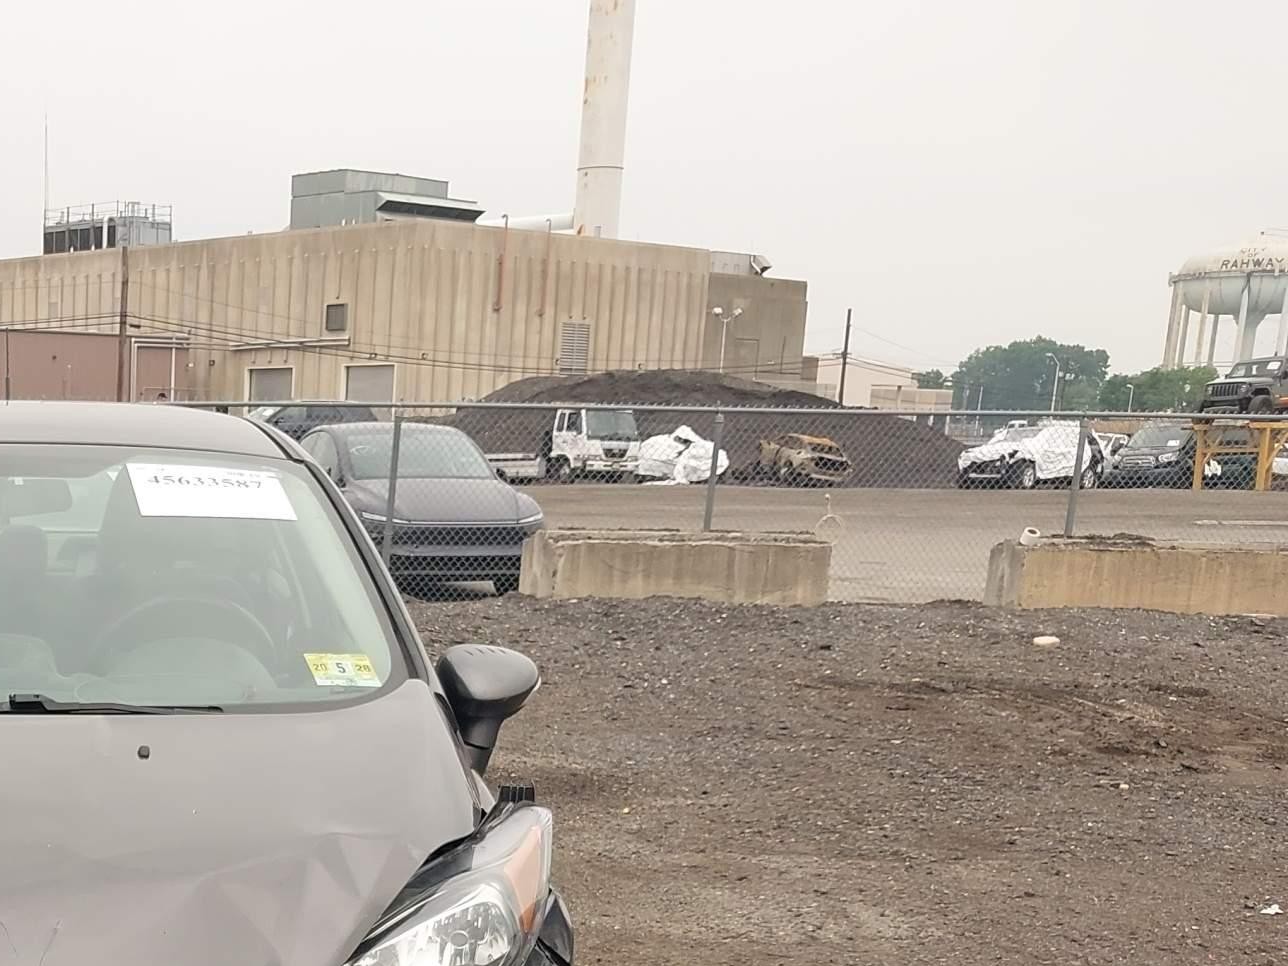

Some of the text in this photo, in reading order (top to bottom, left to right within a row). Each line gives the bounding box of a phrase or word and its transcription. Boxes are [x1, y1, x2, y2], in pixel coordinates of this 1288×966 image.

[1220, 257, 1285, 269] RAHWAY
[147, 475, 262, 489] 45633587
[313, 663, 328, 673] 20
[336, 662, 346, 674] 5
